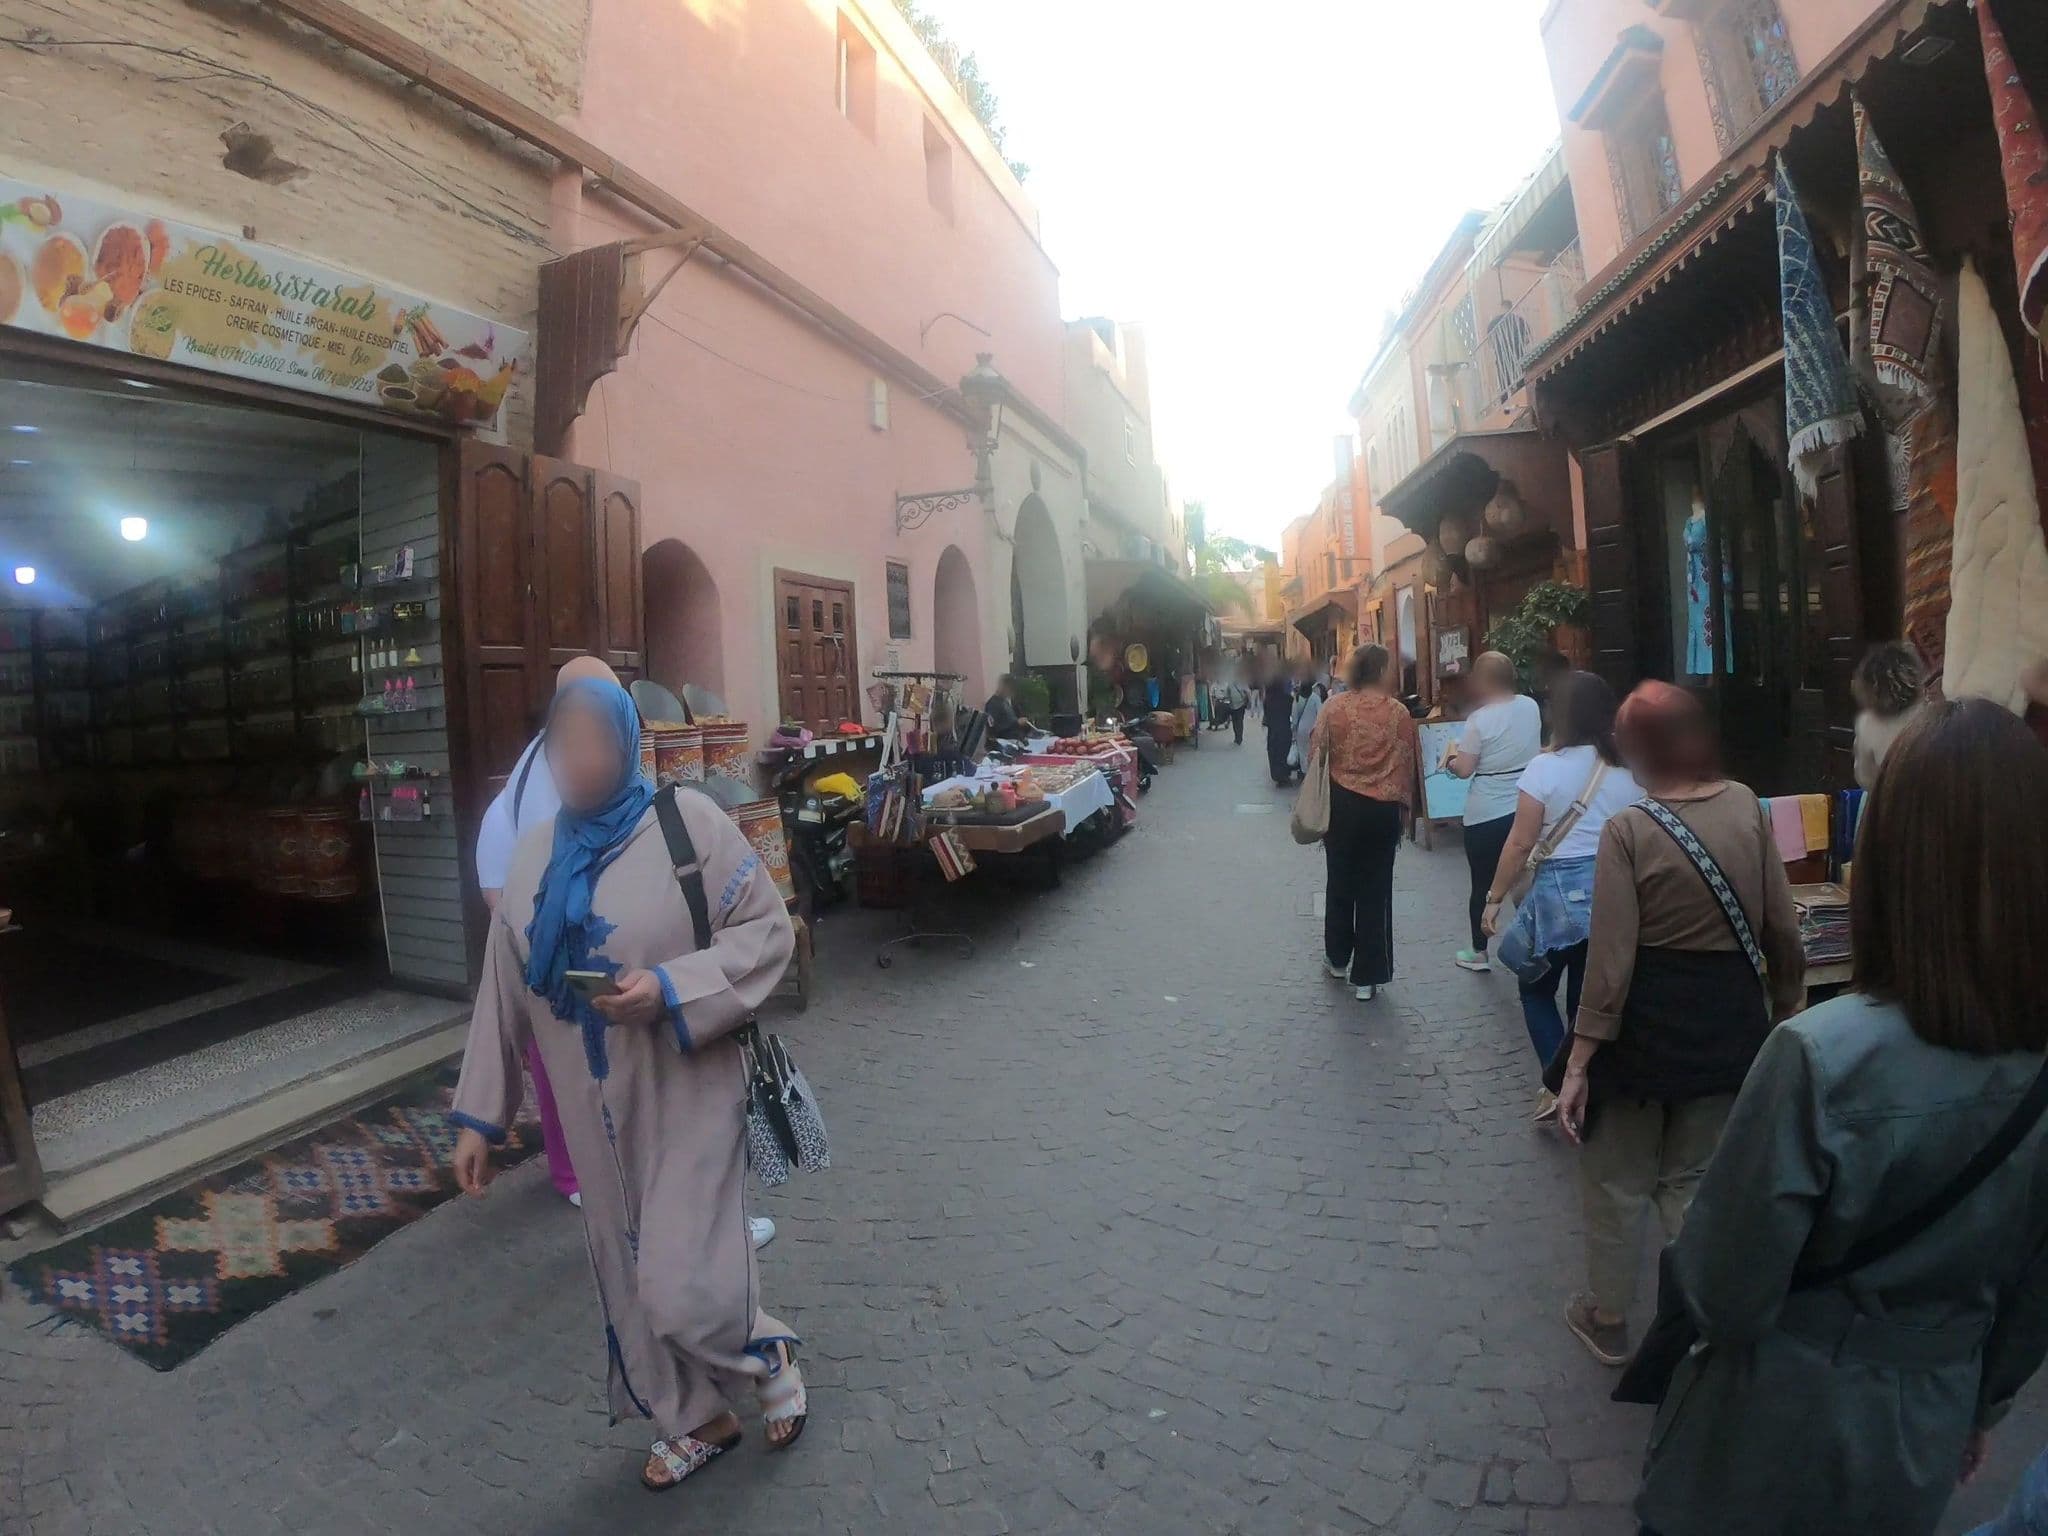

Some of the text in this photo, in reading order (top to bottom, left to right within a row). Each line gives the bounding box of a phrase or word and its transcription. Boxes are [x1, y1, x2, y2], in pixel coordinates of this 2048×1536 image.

[164, 277, 183, 293] LES
[186, 283, 221, 302] EPICES
[230, 296, 268, 316] SAFRAN
[276, 309, 302, 325] HUILE
[340, 324, 364, 341] HUILE
[366, 331, 409, 355] ESSENTIEL
[226, 314, 258, 334] CREME
[262, 324, 321, 348] COSMETIQUE
[327, 341, 345, 356] MIEL
[182, 336, 219, 357] Khalid
